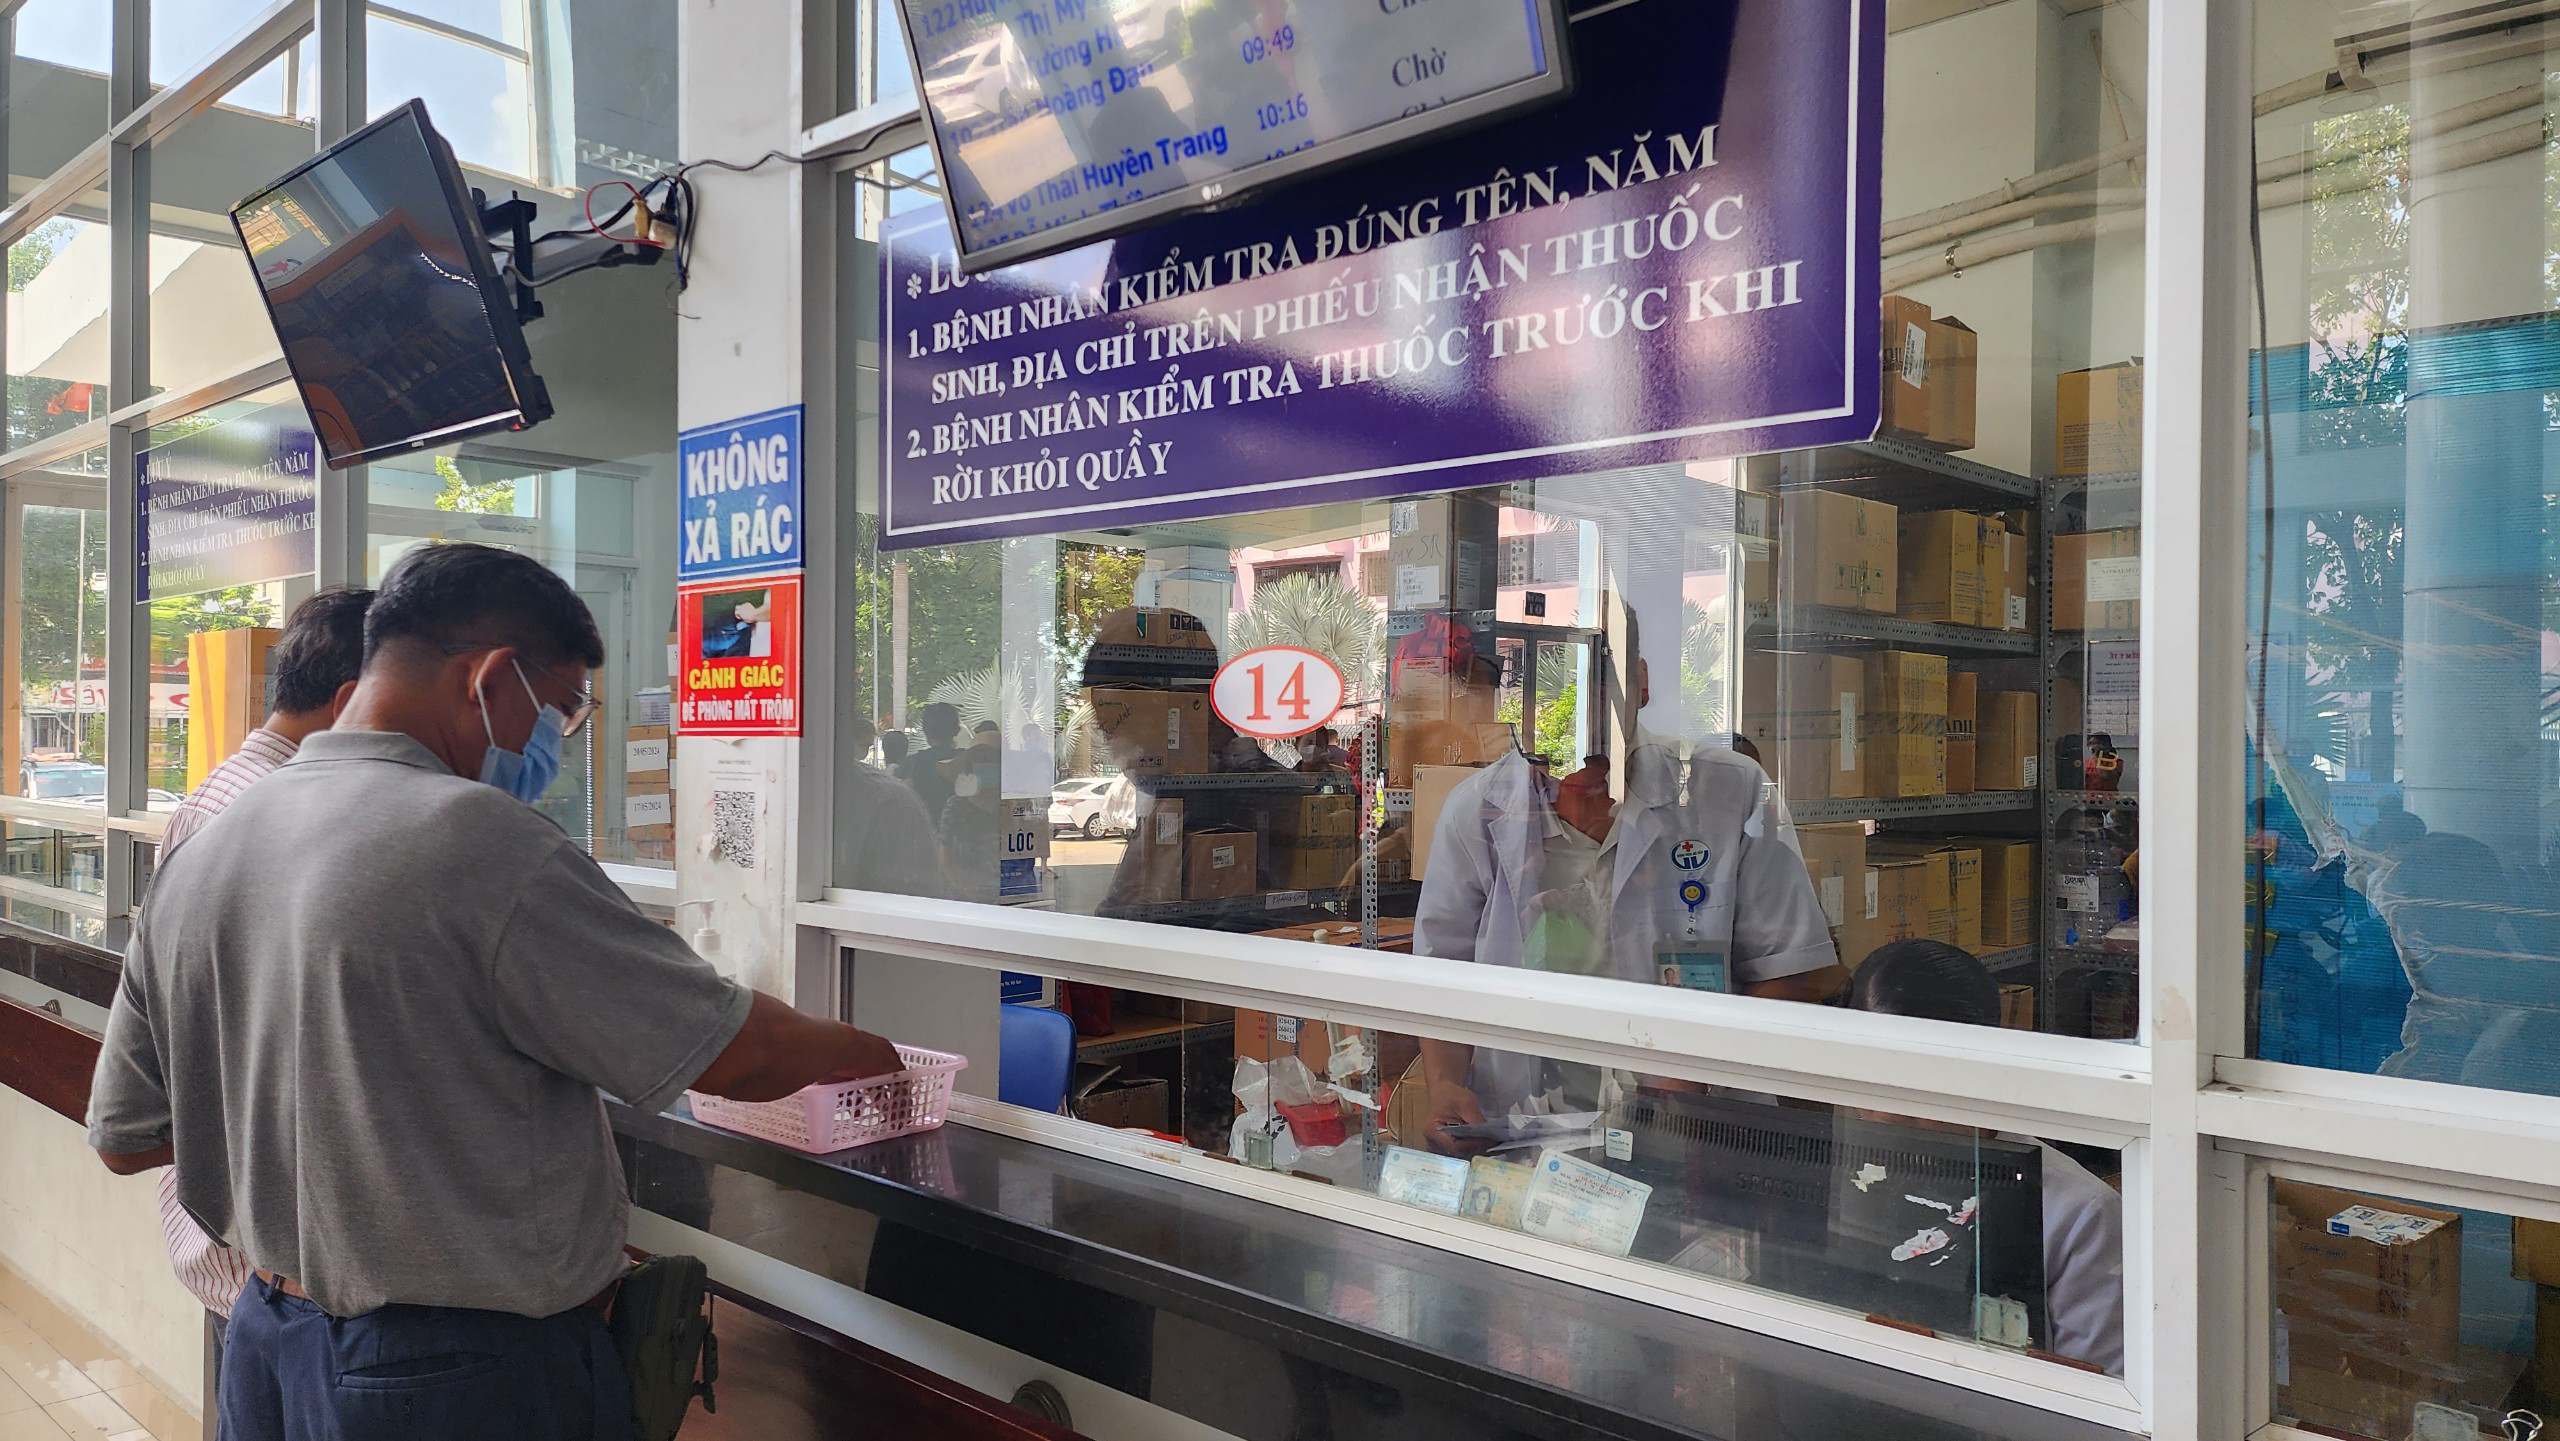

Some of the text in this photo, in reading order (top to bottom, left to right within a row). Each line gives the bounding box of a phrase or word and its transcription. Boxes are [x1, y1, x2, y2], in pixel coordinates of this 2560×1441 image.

[922, 1, 957, 39] 122
[1242, 24, 1295, 65] 09:49
[1392, 47, 1446, 88] Chờ
[1256, 93, 1308, 131] 10:16
[1083, 147, 1155, 189] Huyền
[1156, 125, 1229, 168] Trang
[908, 124, 1720, 359] 1. BỆNH NHÂN KIỂM TRA ĐÚNG TÊN, NĂM
[932, 182, 1744, 405] SINH, ĐỊA CHỈ TRÊN PHIẾU NHẬN THUỐC
[907, 260, 1804, 459] 2. BỆNH NHÂN KIỂM TRA THUỐC TRƯỚC KHI
[148, 494, 169, 515] BỆNH
[168, 487, 192, 507] NHÂN
[216, 478, 234, 495] TRA
[235, 466, 261, 488] ĐÚNG
[285, 451, 309, 475] NĂM
[687, 431, 788, 498] KHÔNG
[932, 429, 1173, 505] RỜI KHỎI QUẦY
[168, 517, 182, 537] ĐỊA
[199, 502, 222, 527] TRÊN
[222, 491, 250, 522] PHIẾU
[250, 489, 278, 515] NHẬN
[278, 476, 314, 506] THUỐC
[216, 532, 234, 551] TRA
[235, 517, 266, 544] THUỐC
[267, 512, 301, 539] TRƯỚC
[302, 511, 316, 532] KH
[685, 494, 793, 565] XẢ RÁC
[689, 659, 784, 690] CẢNH GIÁC
[1246, 661, 1311, 721] 14
[682, 691, 794, 724] ĐỀ PHÒNG MẤT TRỘM
[633, 746, 660, 757] 20/05/2024
[634, 801, 662, 813] 17/05/2024
[1008, 828, 1035, 855] LỘC
